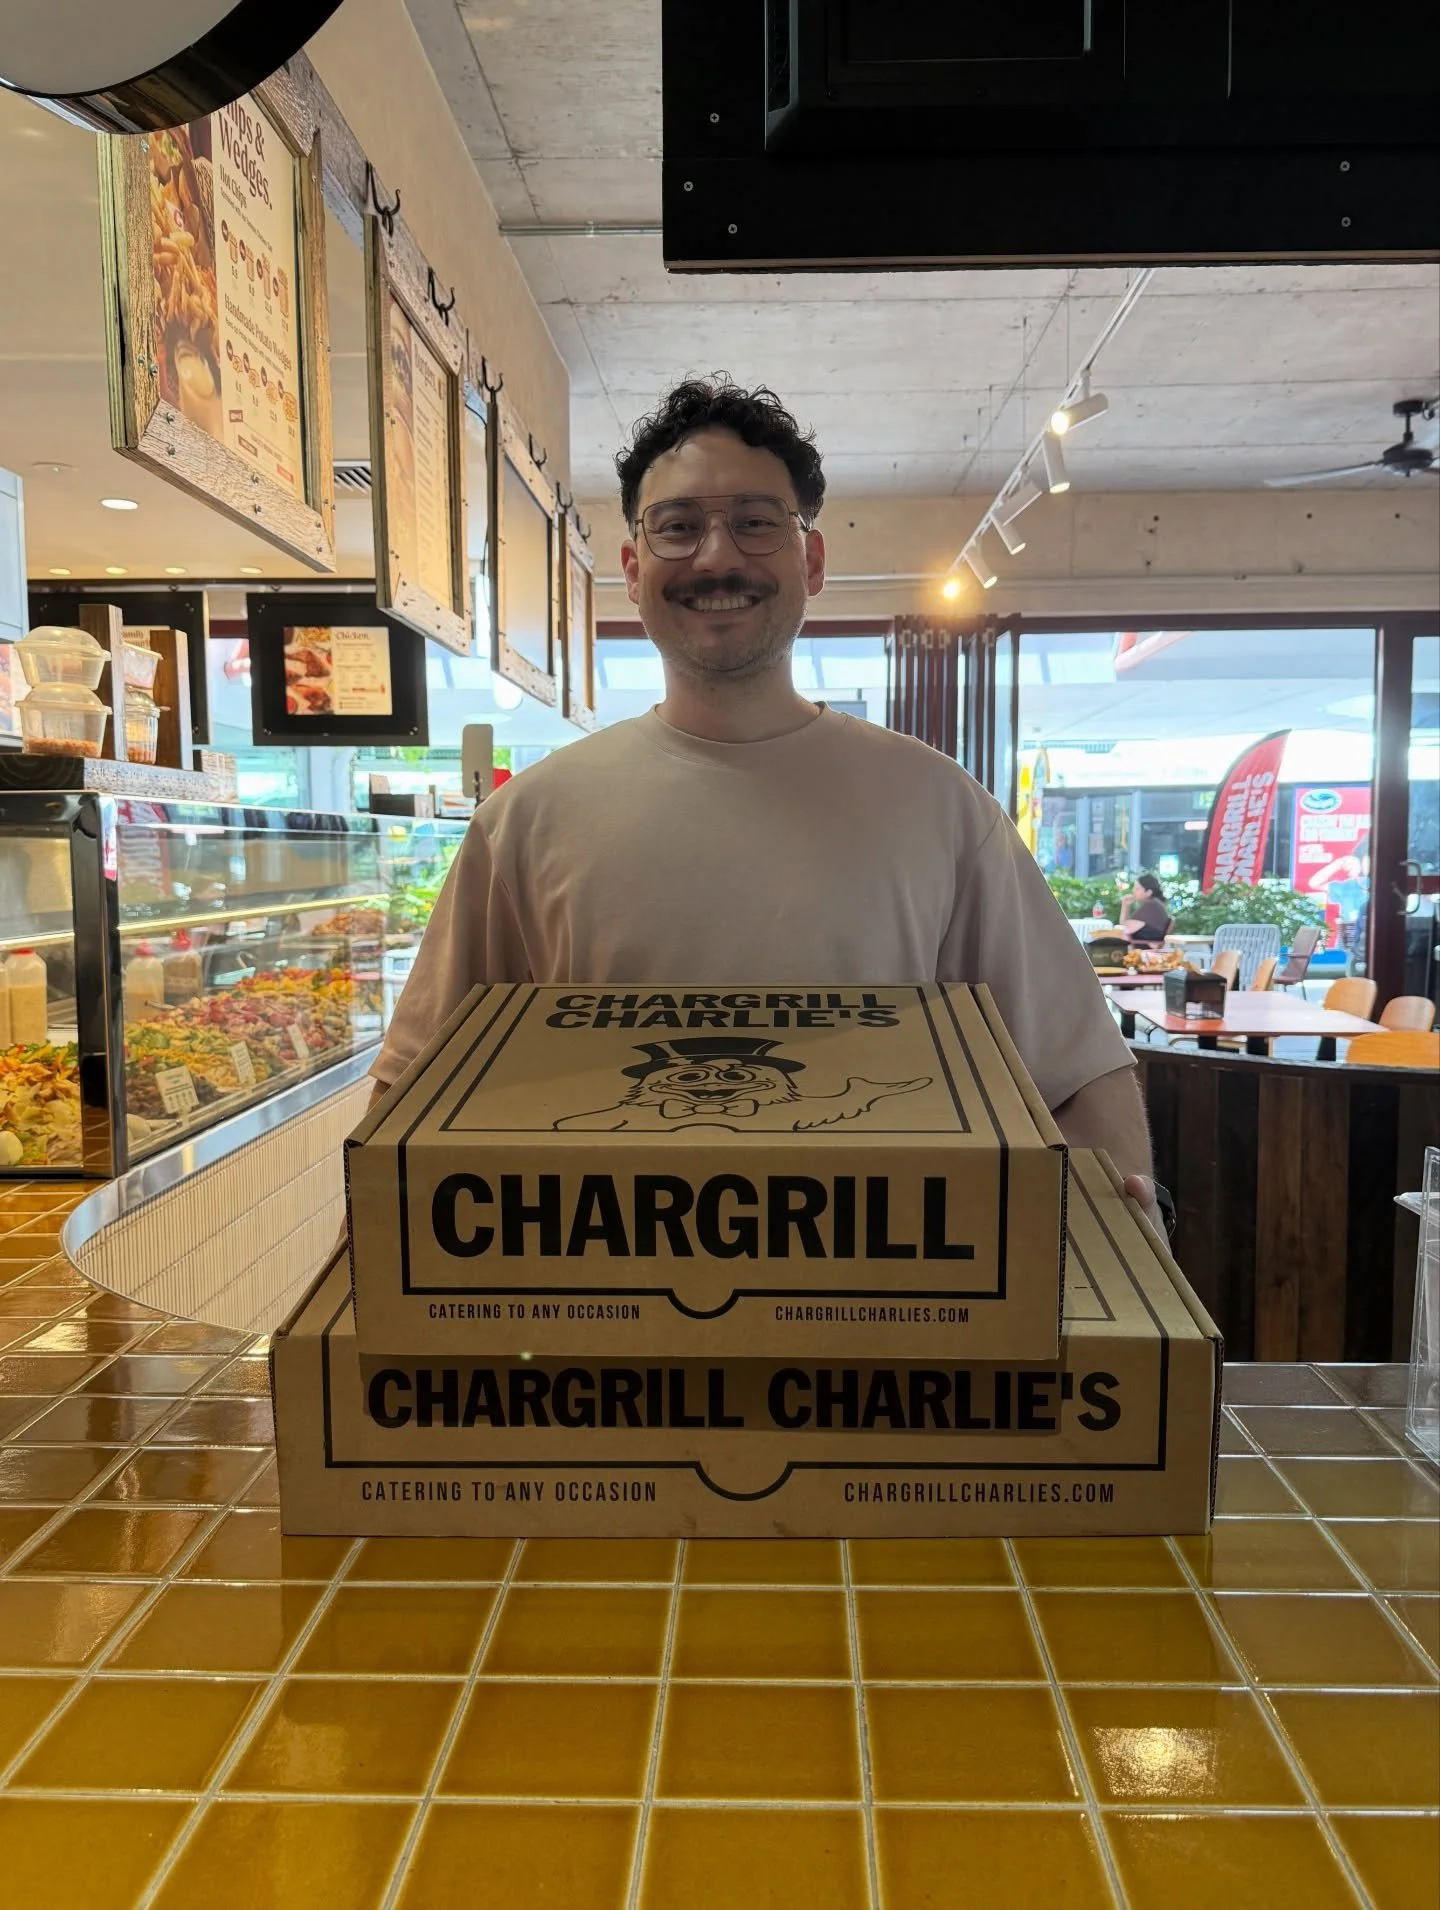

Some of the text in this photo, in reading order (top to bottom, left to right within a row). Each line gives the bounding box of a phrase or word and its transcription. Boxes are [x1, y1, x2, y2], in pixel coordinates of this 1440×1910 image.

[226, 100, 265, 162] hips &
[218, 110, 273, 211] Wedges.
[1213, 774, 1252, 882] HARGRILL
[556, 993, 896, 1009] CHARGRILL
[546, 1010, 900, 1029] CHARLIE'S
[431, 1172, 975, 1260] CHARGRILL
[429, 1304, 640, 1320] CATERING TO ANY OCCASION
[775, 1305, 970, 1323] CHARGRILLCHARLIES.COM
[368, 1367, 1121, 1431] CHARGRILL CHARLIE'S
[362, 1481, 656, 1502] CATERING TO ANY OCCASION
[844, 1482, 1115, 1503] CHARGRILLCHARLIES.COM
